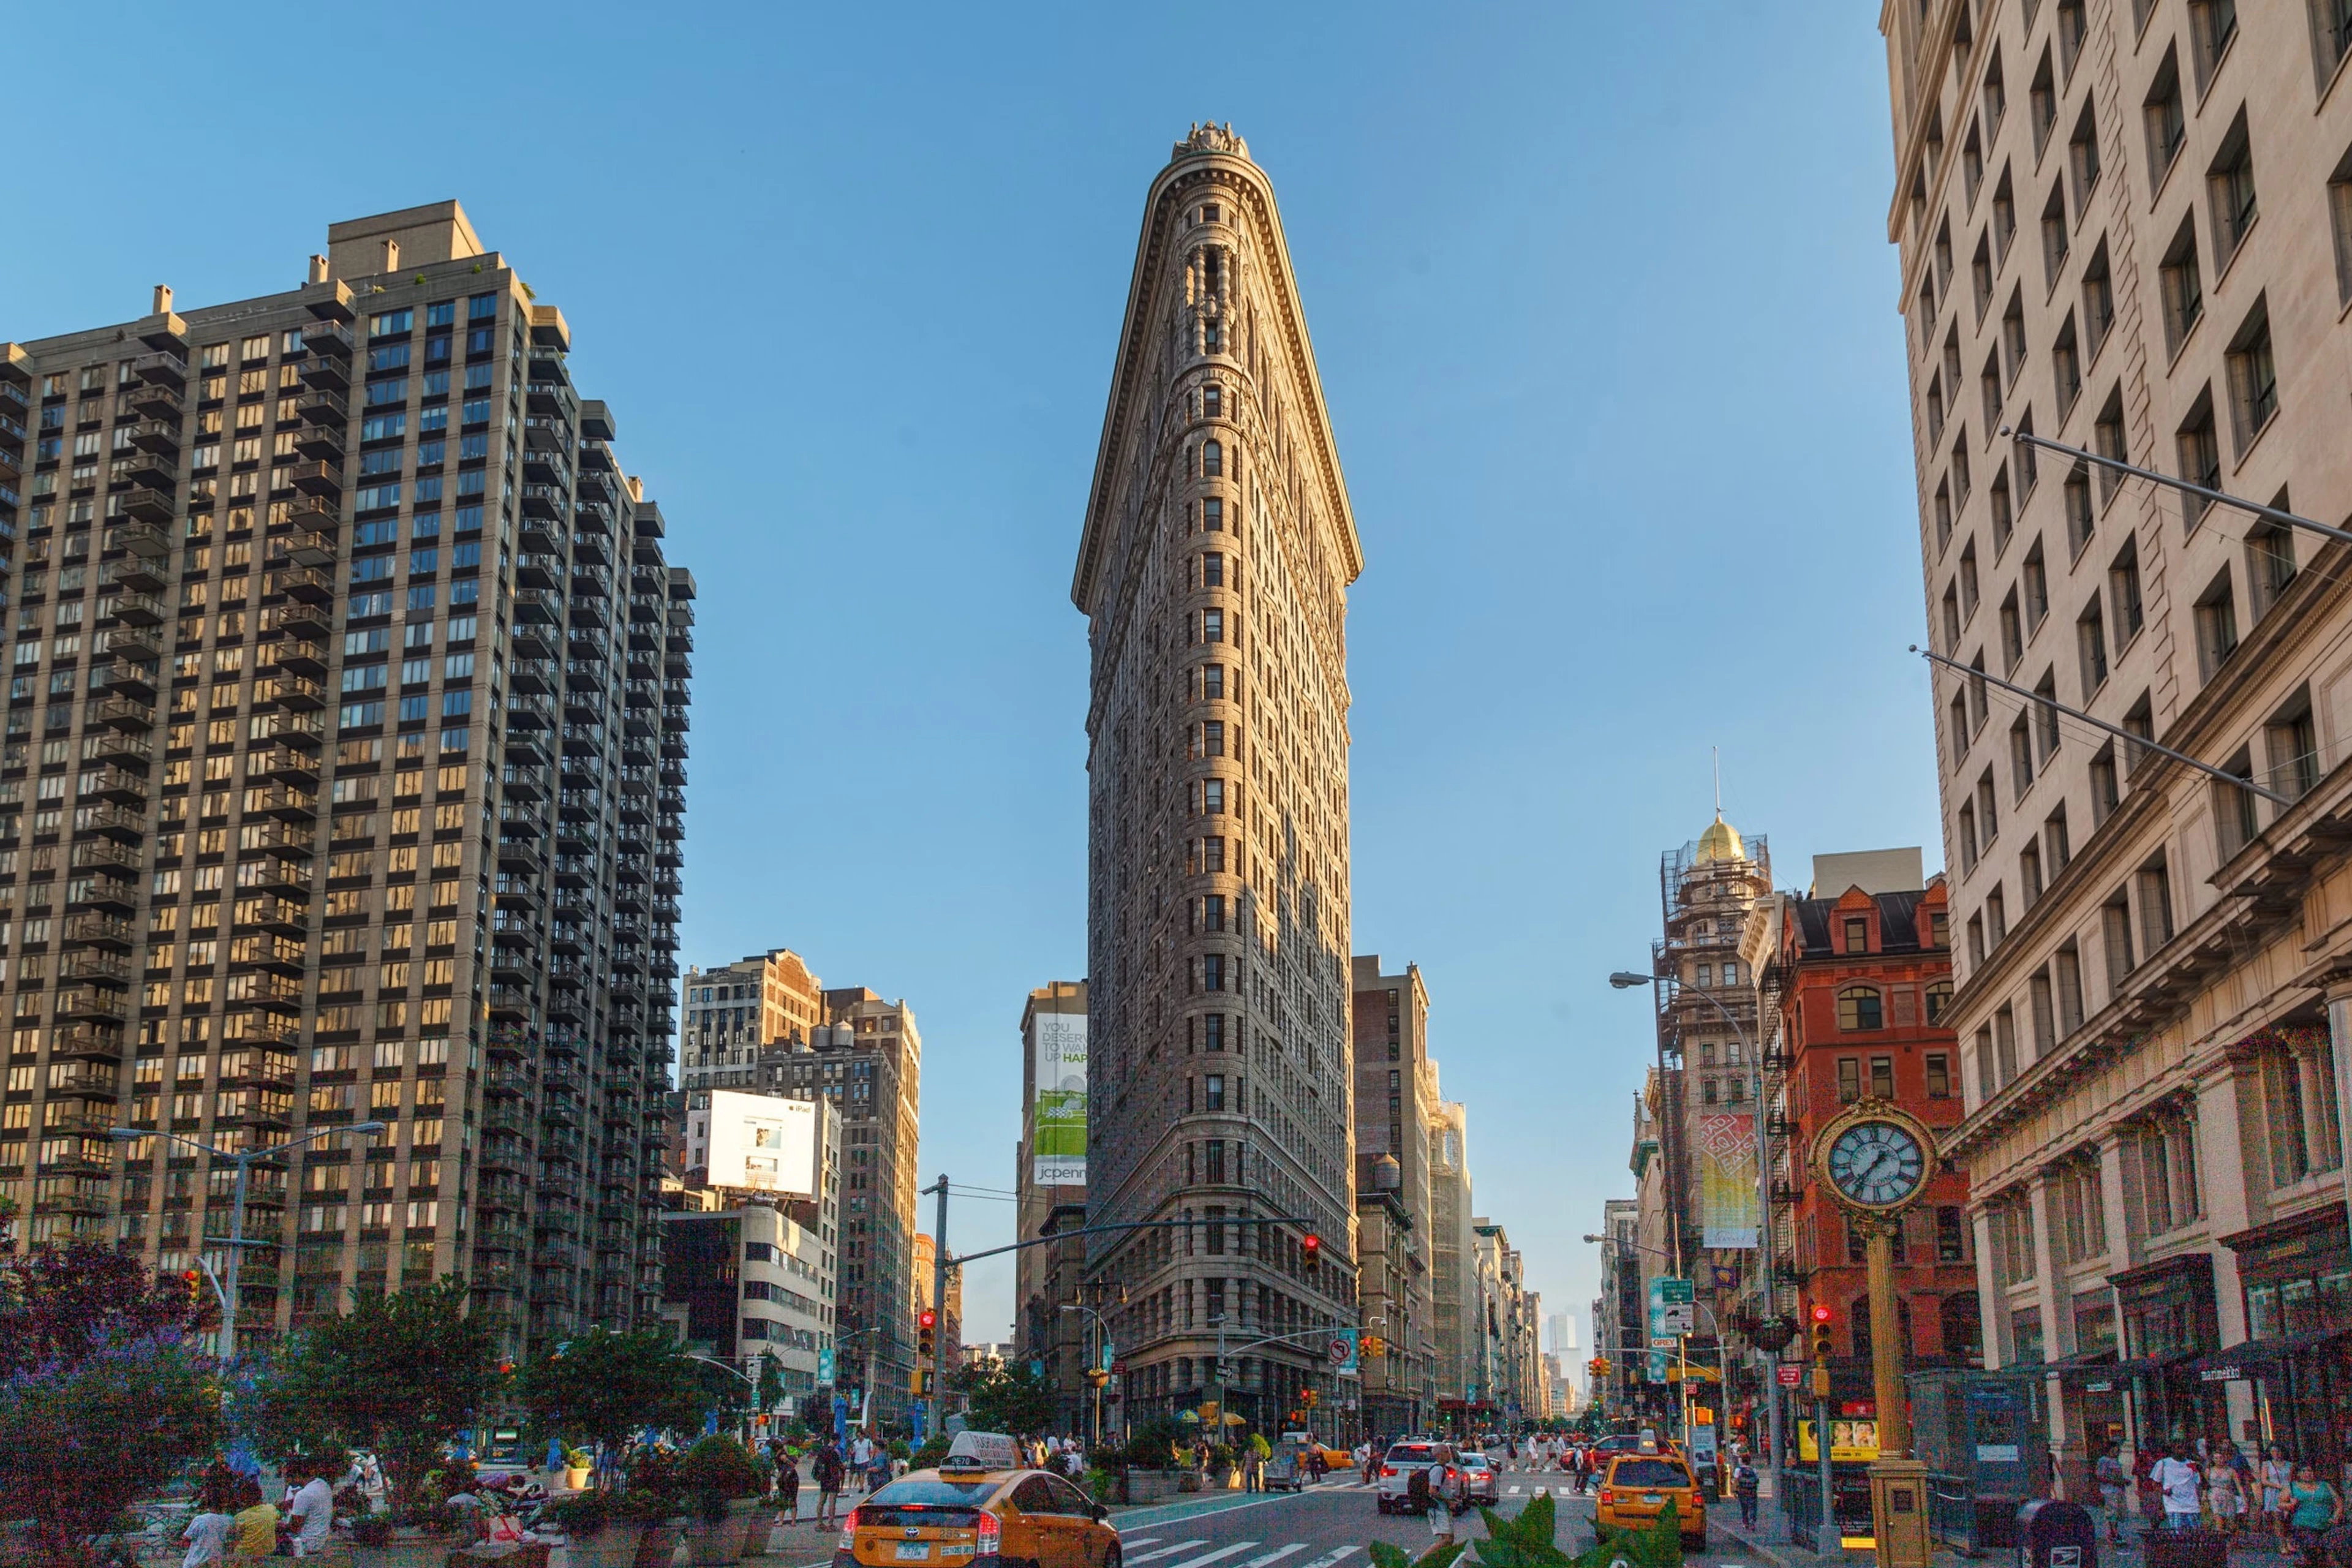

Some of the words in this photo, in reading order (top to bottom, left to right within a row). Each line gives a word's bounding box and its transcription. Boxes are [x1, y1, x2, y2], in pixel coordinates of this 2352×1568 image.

[1044, 1022, 1070, 1033] YOU
[1042, 1042, 1060, 1052] TO
[1045, 1053, 1061, 1062] UP
[1064, 1053, 1088, 1063] HAP
